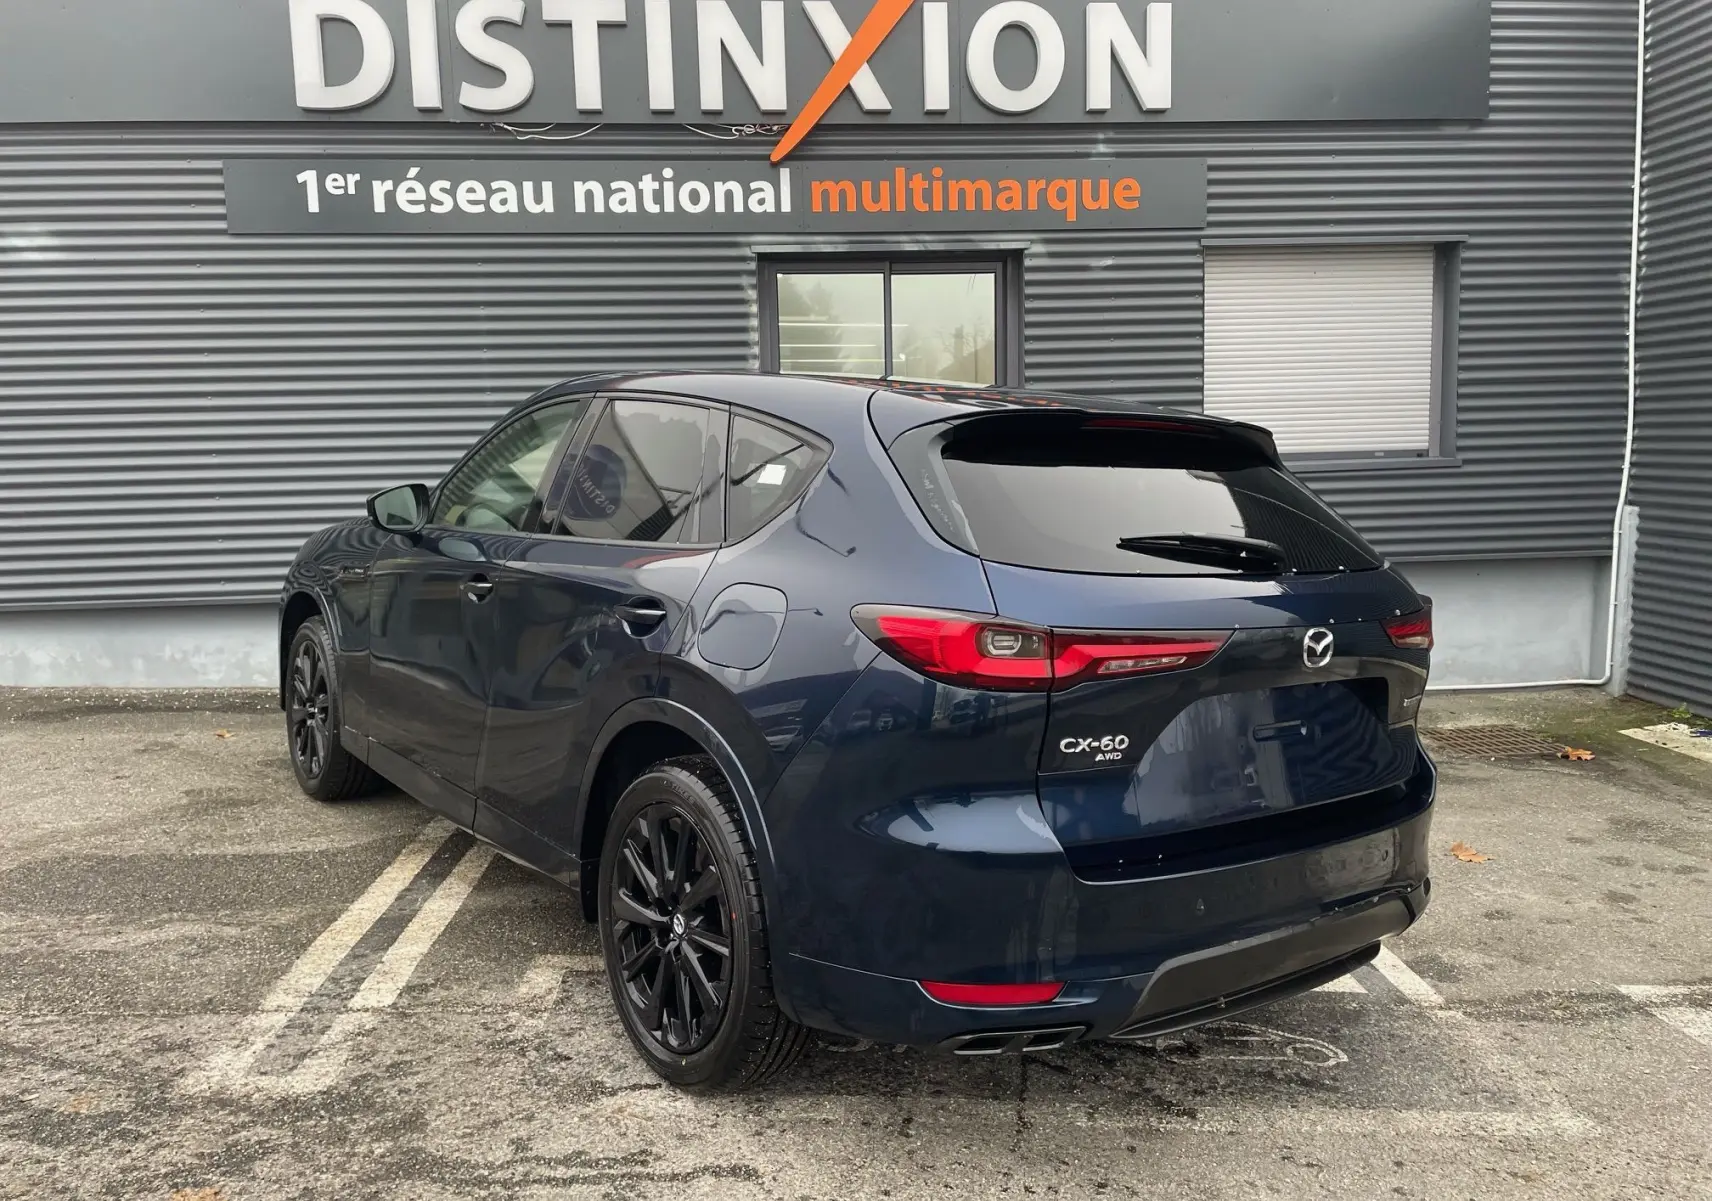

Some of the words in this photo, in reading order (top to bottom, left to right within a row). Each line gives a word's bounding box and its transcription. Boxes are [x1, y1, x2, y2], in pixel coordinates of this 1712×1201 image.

[289, 0, 1172, 162] DISTINXION
[296, 169, 360, 213] 1er
[372, 167, 554, 214] réseau
[573, 168, 791, 214] national
[811, 167, 1141, 221] multimarque
[1060, 735, 1129, 753] CX-60
[1095, 752, 1122, 762] AWD
